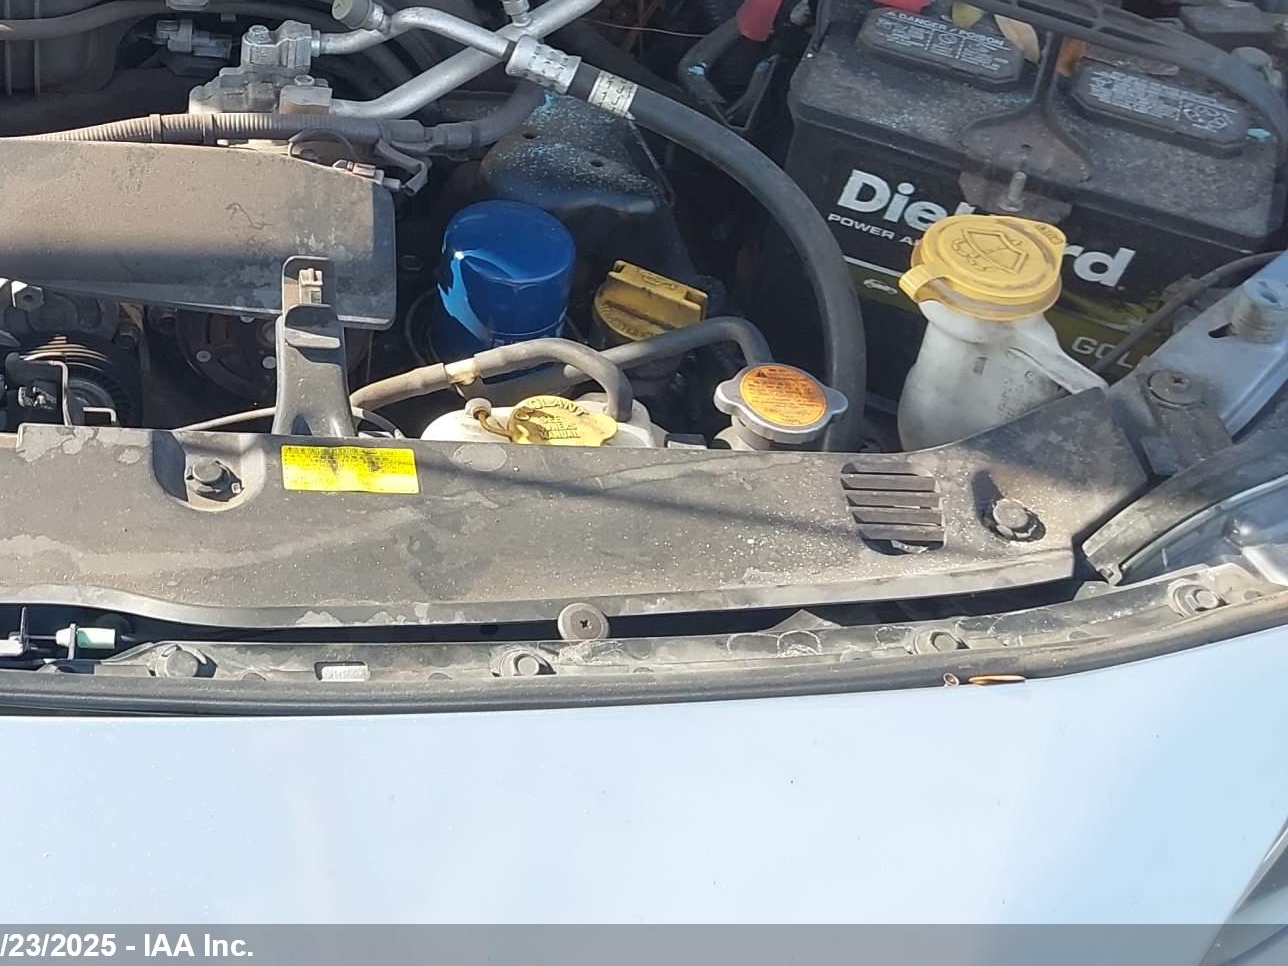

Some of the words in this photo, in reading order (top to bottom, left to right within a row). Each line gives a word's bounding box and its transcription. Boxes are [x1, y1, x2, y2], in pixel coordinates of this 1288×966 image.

[898, 12, 947, 31] DANGER
[827, 212, 896, 241] POWER
[837, 169, 1136, 288] Dierd
